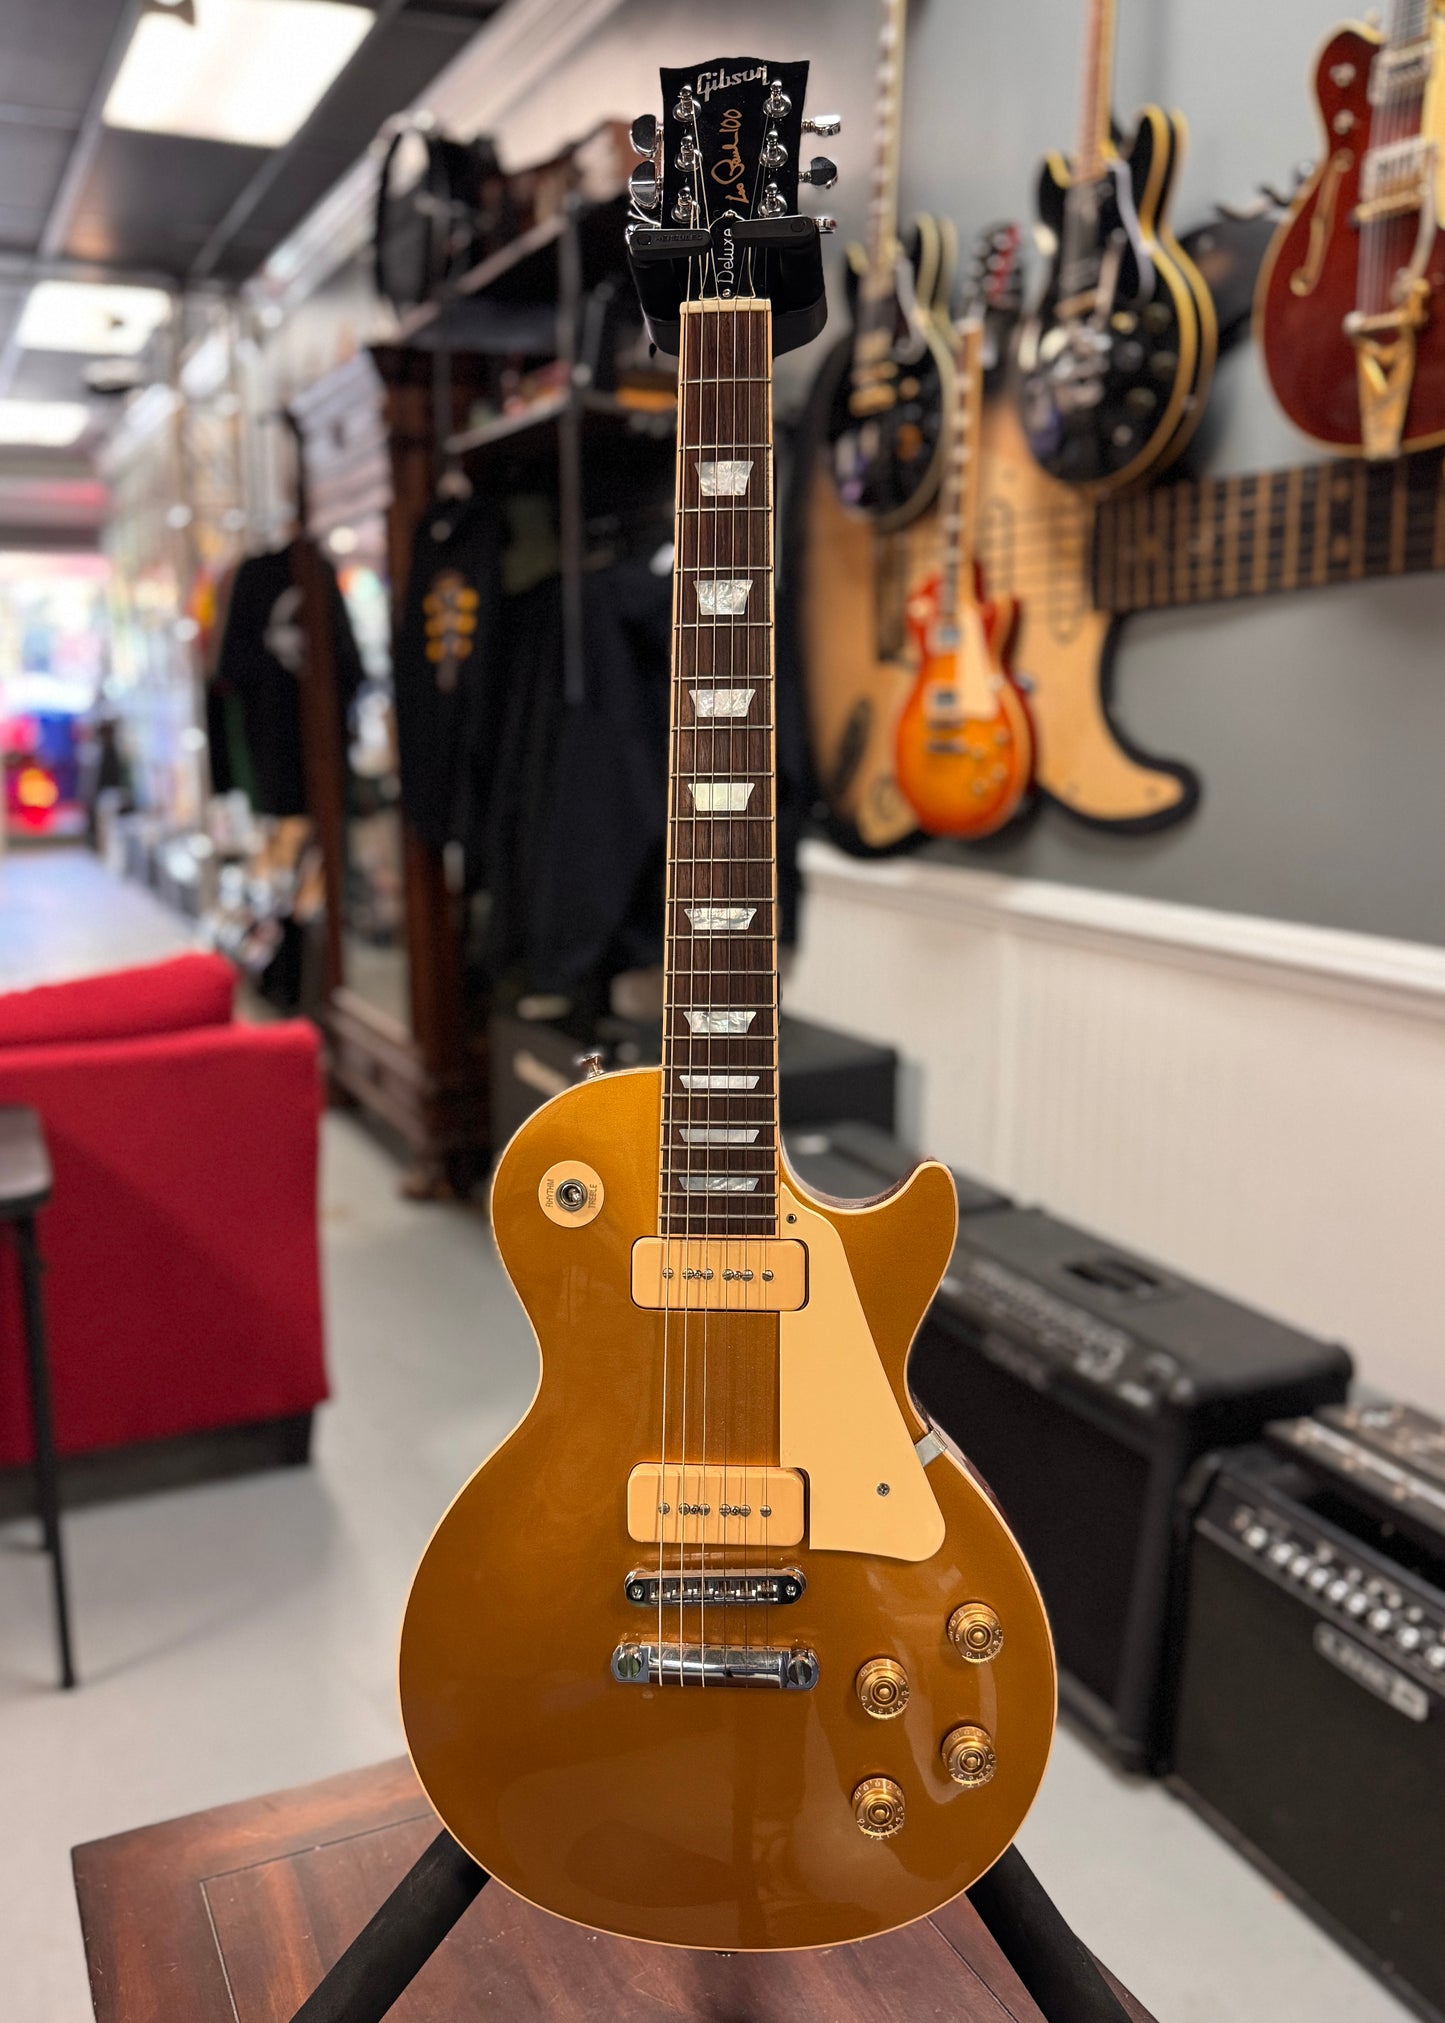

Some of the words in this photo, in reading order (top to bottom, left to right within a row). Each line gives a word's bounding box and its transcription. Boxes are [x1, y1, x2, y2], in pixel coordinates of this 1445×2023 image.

[697, 65, 770, 102] Gibson
[719, 109, 742, 132] 100
[711, 131, 745, 185] Paul
[725, 182, 750, 204] Les
[717, 228, 734, 284] Deluxe
[546, 1179, 555, 1208] RHYTHM
[588, 1184, 598, 1209] TREBLE
